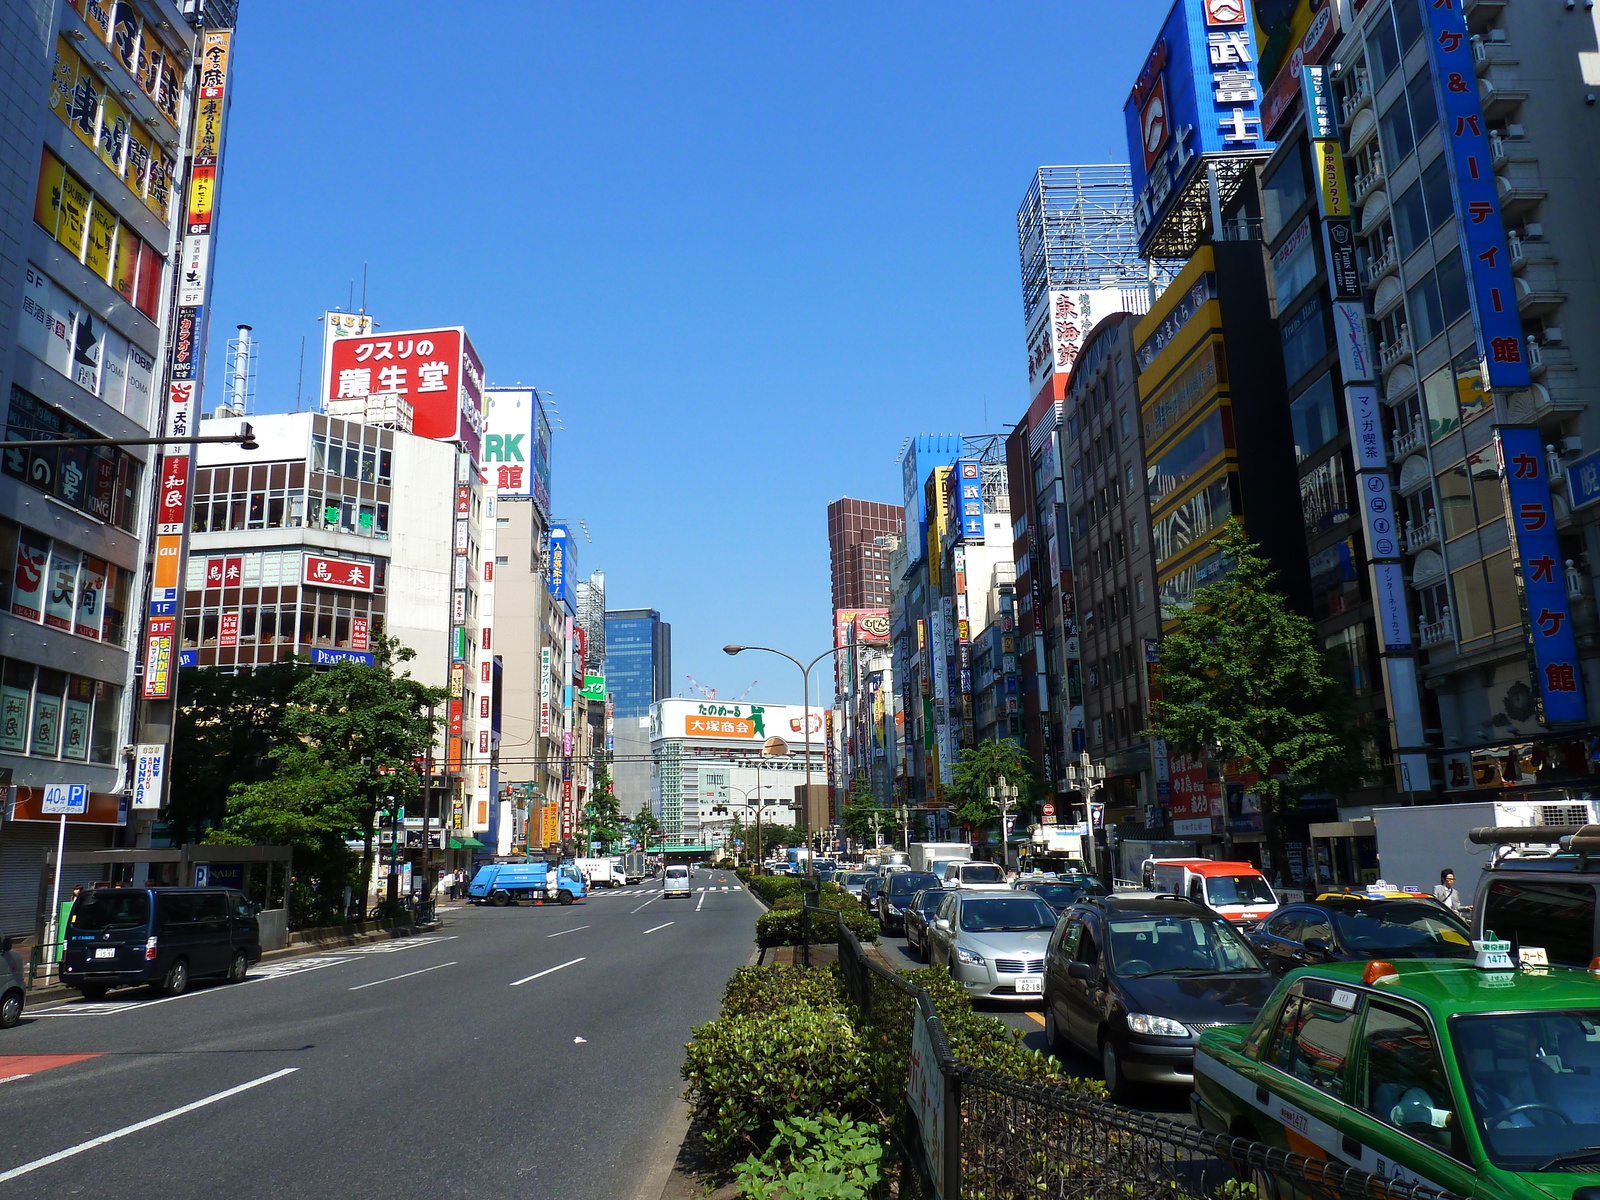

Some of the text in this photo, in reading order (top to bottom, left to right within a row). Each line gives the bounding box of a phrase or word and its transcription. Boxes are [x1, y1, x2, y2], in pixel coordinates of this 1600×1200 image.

[202, 46, 226, 88] 金の蔵
[205, 88, 219, 97] 8F
[1208, 31, 1261, 141] 武富士
[201, 157, 213, 165] 7F
[1324, 156, 1341, 215] 中央コンタクト
[191, 224, 207, 233] 6F
[1279, 221, 1309, 263] 中央コンタクト
[26, 269, 44, 288] 5F
[1340, 245, 1355, 294] Trans Hair
[118, 277, 131, 293] 6F
[1055, 294, 1080, 367] 東海苑
[1156, 304, 1189, 349] かまくら
[1284, 300, 1317, 339] Trans Hair
[177, 318, 192, 363] カラオケ
[355, 340, 435, 362] クスリの
[174, 363, 191, 371] KING
[337, 361, 449, 399] 龍生堂
[173, 411, 187, 437] 天狗
[1358, 396, 1378, 459] マンガ喫茶
[482, 434, 525, 462] RK
[165, 475, 184, 507] 和民
[963, 485, 982, 533] 武富士
[163, 525, 177, 533] 2F
[160, 546, 177, 556] au
[1513, 453, 1577, 692] カラオケ館
[156, 604, 170, 612] 1F
[1384, 567, 1402, 643] インターネットカフェ
[151, 623, 171, 632] B1F
[155, 637, 170, 694] まんが喫茶
[699, 704, 741, 717] たのめーる
[690, 721, 750, 733] 大塚商会
[71, 787, 82, 800] P
[136, 757, 147, 804] SUNPARK
[1487, 954, 1507, 963] 1477
[1523, 952, 1544, 961] カード
[1021, 983, 1040, 991] 62-18
[1292, 1110, 1308, 1132] 1477
